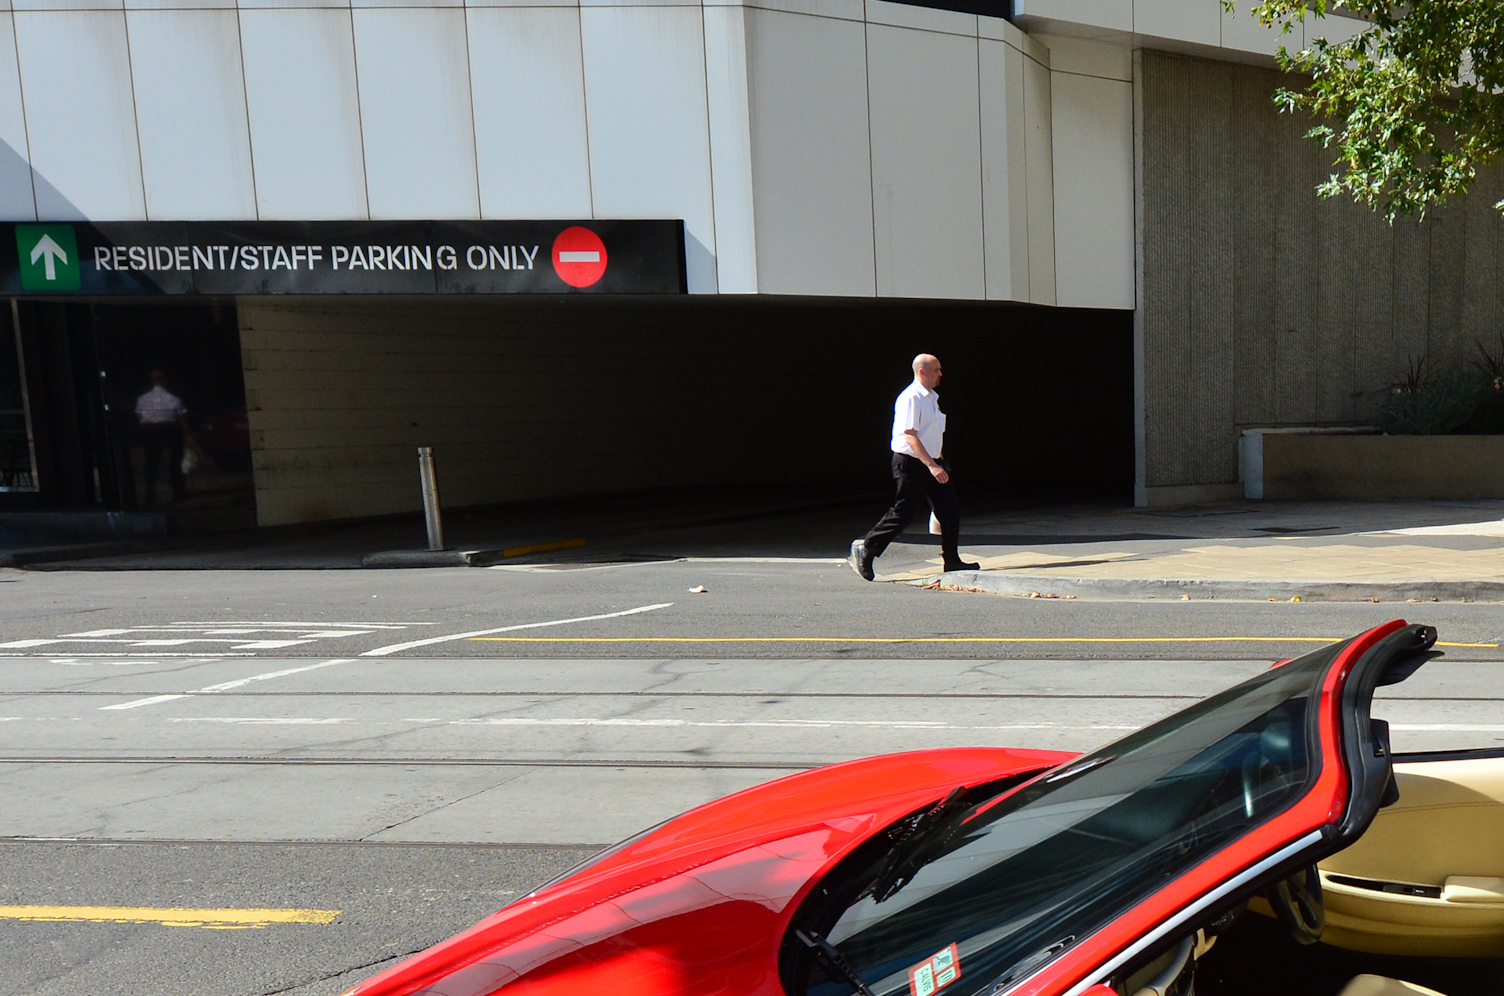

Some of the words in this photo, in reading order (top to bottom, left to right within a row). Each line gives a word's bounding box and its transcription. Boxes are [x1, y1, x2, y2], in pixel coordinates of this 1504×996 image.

[94, 246, 322, 271] RESIDENT/STAFF
[331, 245, 457, 271] PARKING
[466, 245, 540, 271] ONLY
